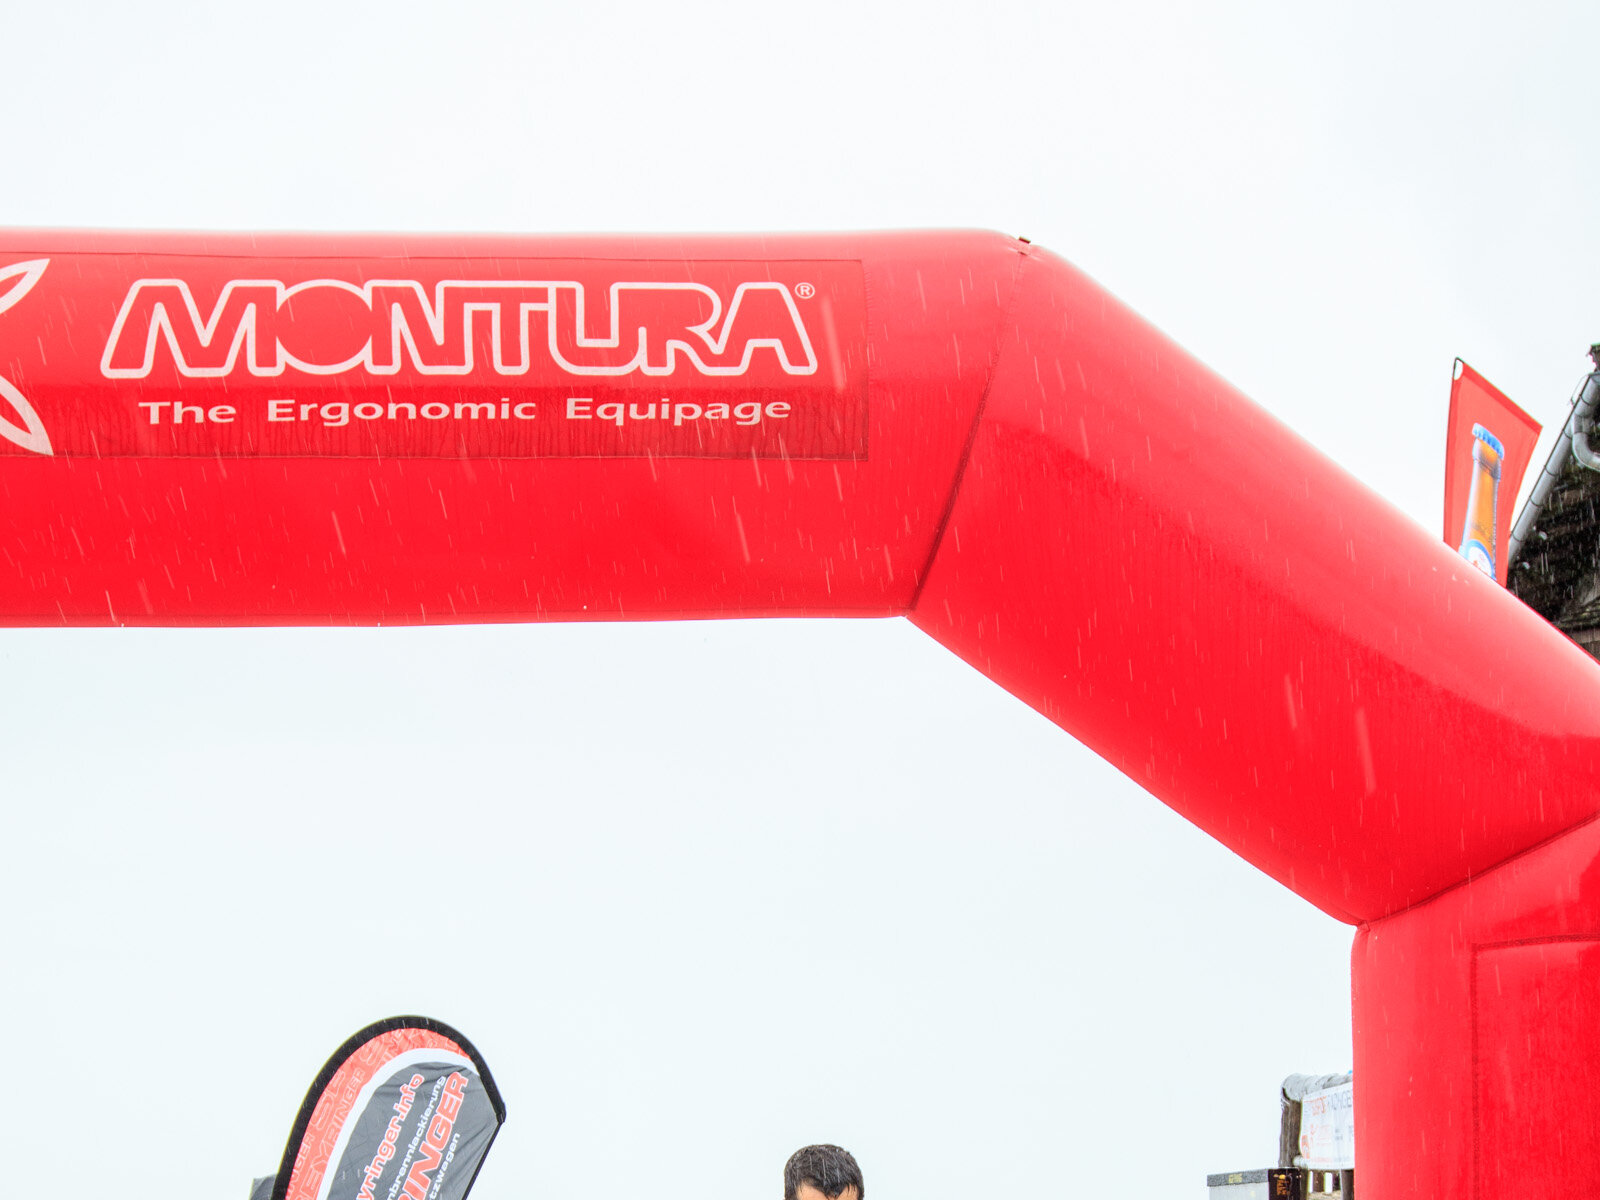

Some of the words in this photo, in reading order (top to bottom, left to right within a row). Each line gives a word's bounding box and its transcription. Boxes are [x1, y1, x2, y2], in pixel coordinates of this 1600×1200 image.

[138, 401, 238, 425] The
[267, 398, 537, 427] Ergonomic
[566, 397, 792, 427] Equipage
